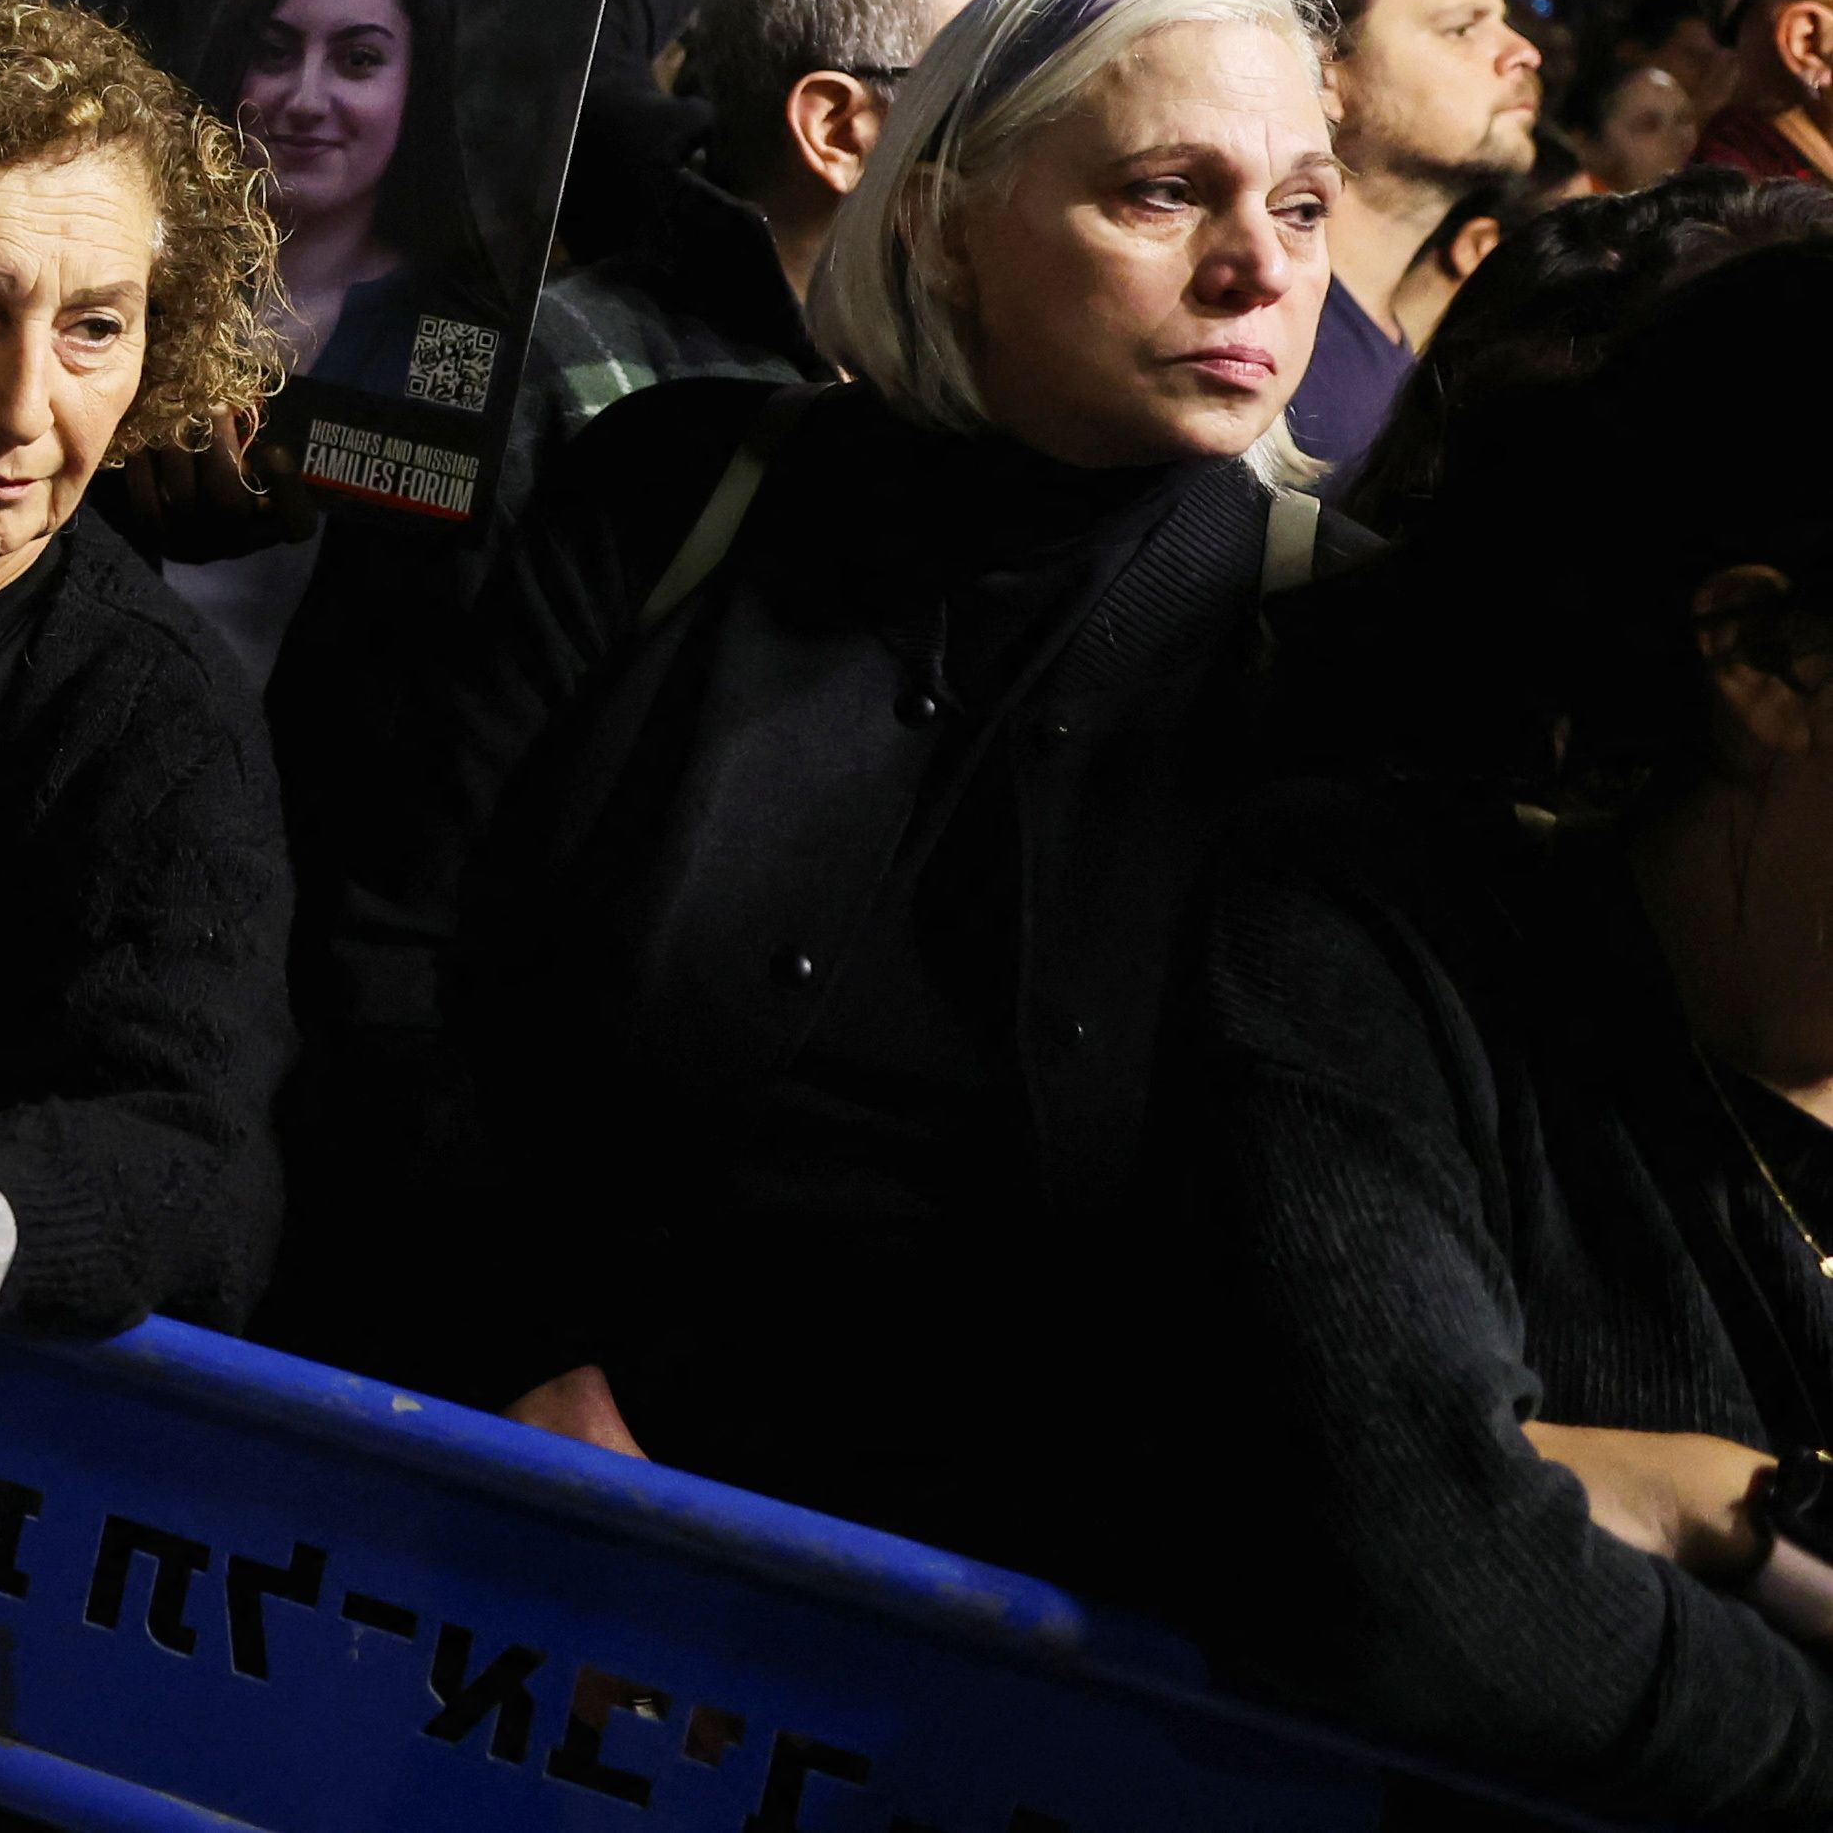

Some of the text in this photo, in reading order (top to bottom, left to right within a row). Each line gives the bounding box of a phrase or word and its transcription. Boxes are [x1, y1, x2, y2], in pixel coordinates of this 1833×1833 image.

[302, 442, 476, 515] FAMILIES FORUM
[309, 418, 481, 481] HOSTAGES AND MISSING
